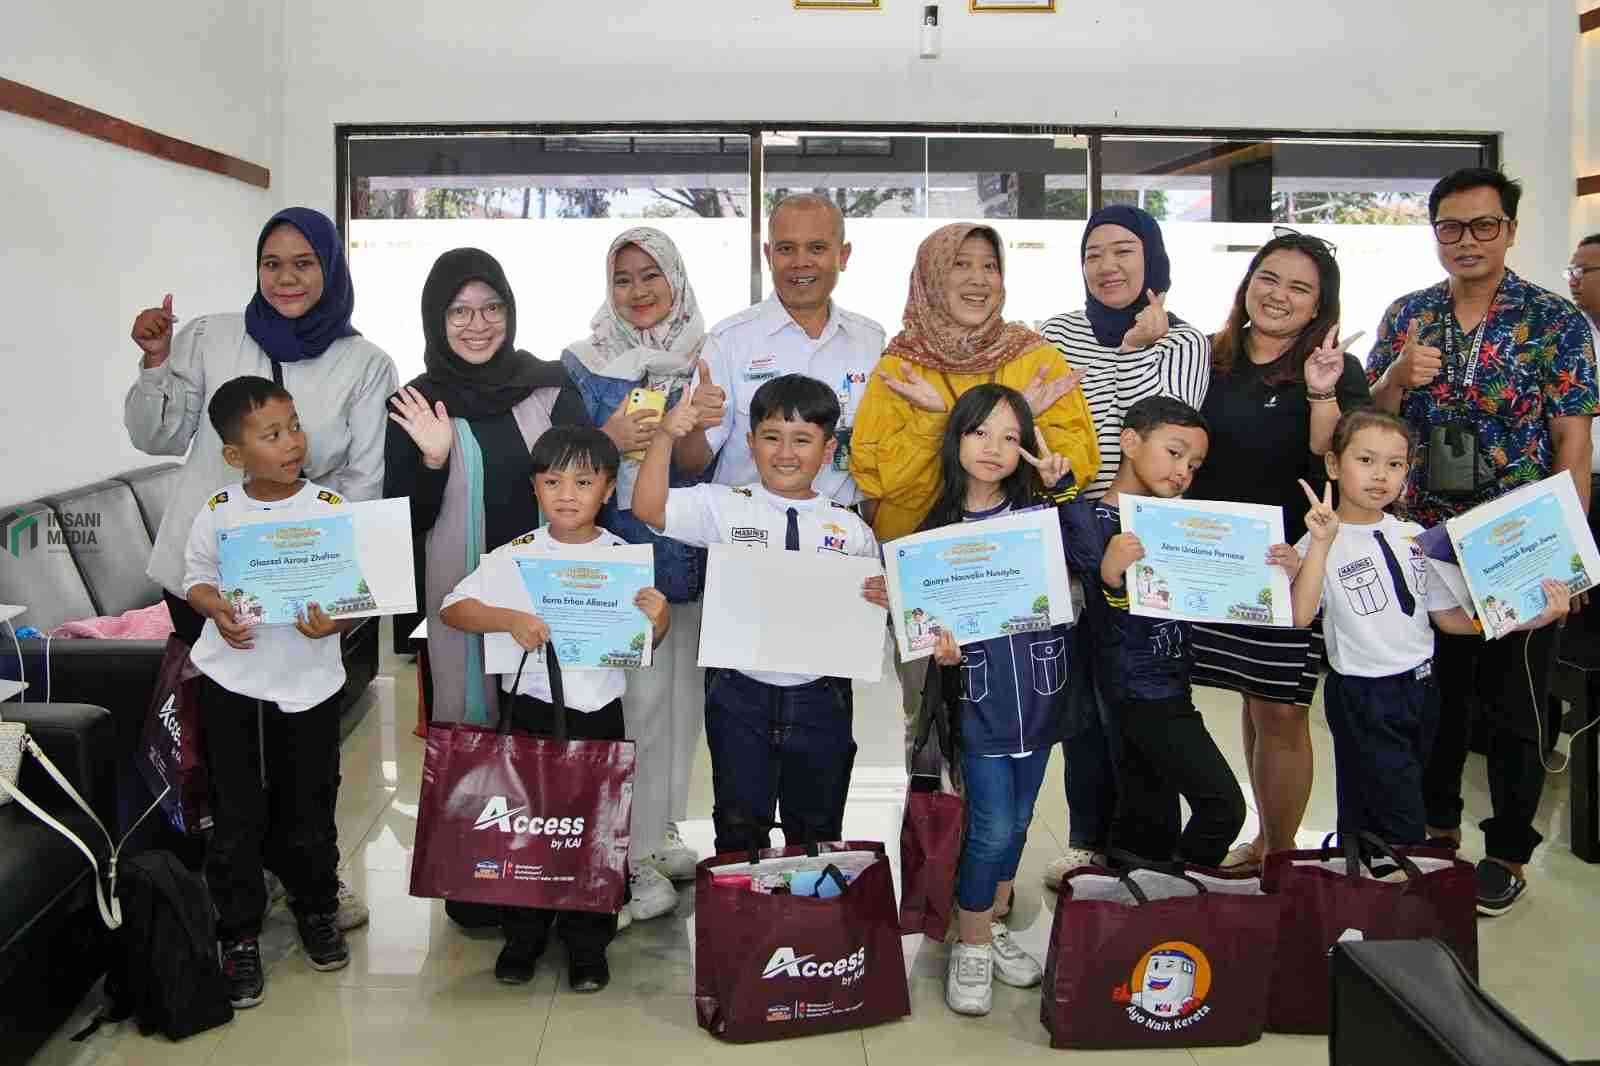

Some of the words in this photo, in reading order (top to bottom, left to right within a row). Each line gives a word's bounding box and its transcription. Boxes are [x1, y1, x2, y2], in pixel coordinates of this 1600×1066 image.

[472, 795, 585, 836] Access
[550, 839, 562, 850] by
[564, 838, 582, 849] KAI
[1126, 1005, 1145, 1023] Ayo
[1145, 1018, 1172, 1032] Naik
[1174, 1005, 1211, 1029] Kereta
